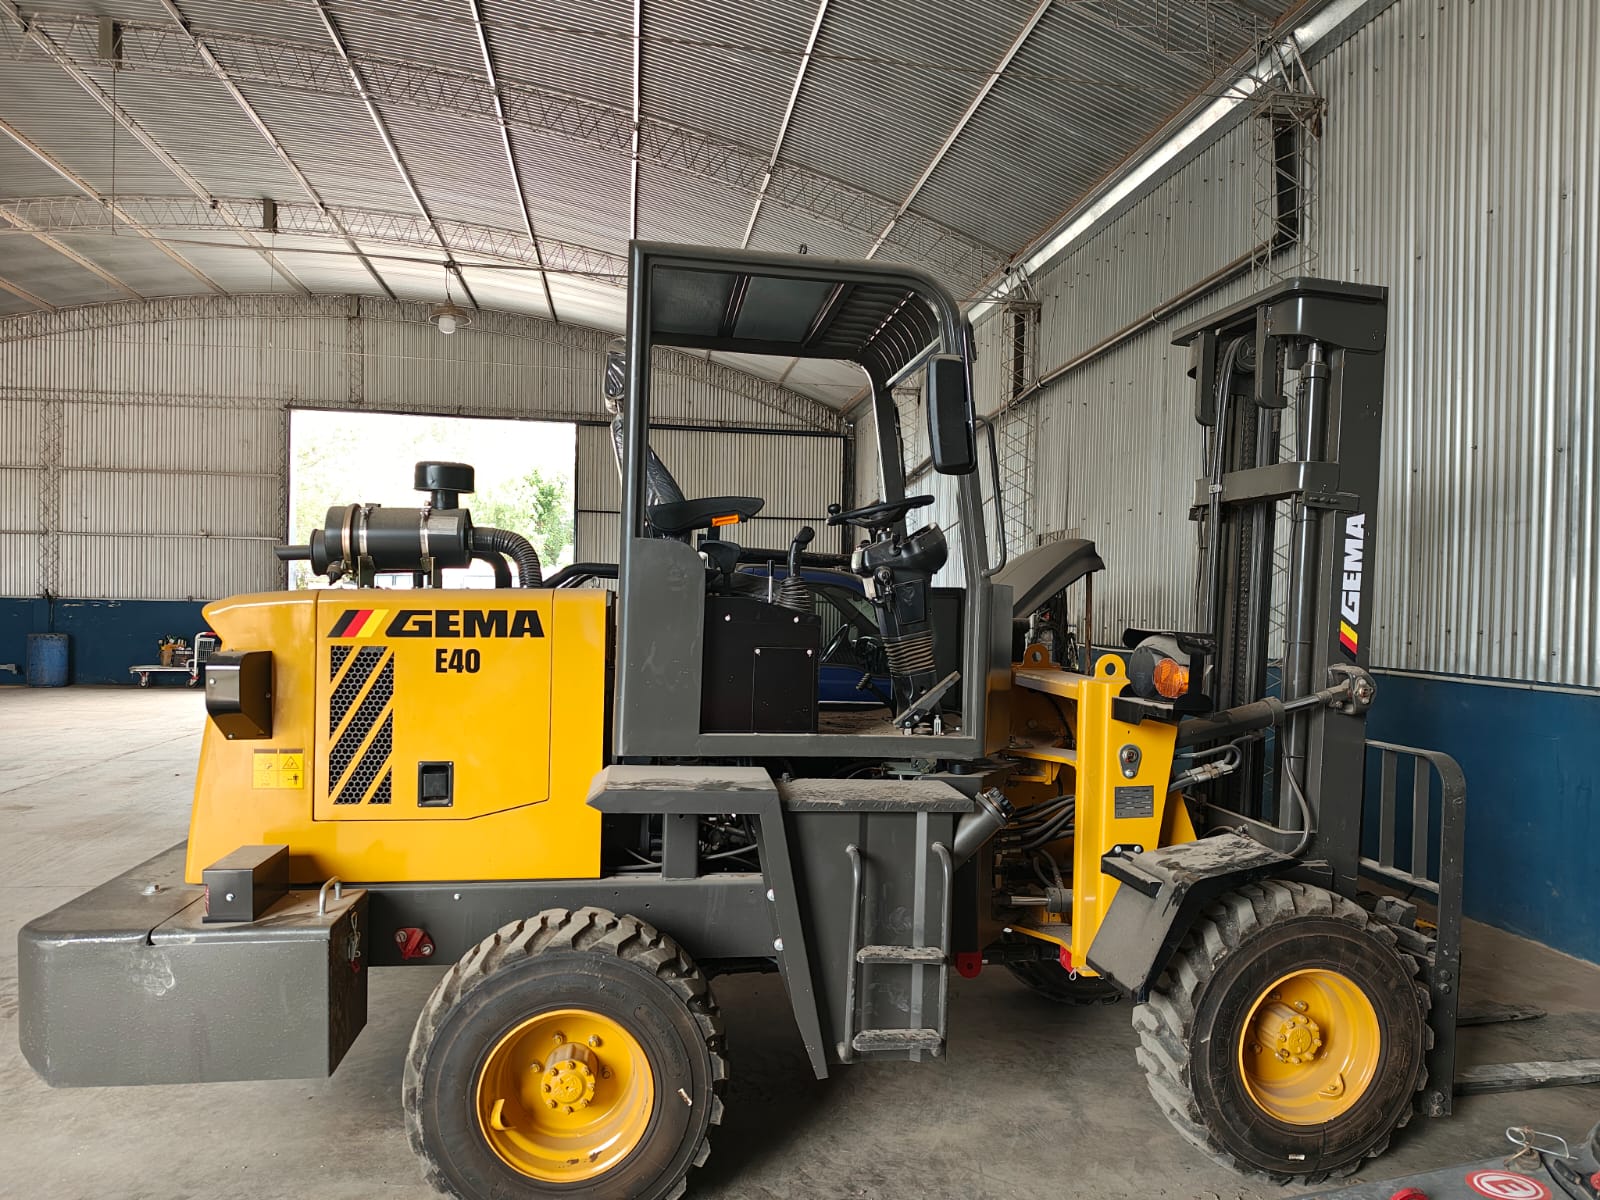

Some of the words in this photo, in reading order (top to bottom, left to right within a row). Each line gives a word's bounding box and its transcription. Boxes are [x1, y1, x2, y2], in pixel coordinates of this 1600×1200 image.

[1341, 513, 1365, 625] GEMA
[385, 609, 545, 638] GEMA
[435, 648, 481, 673] E40
